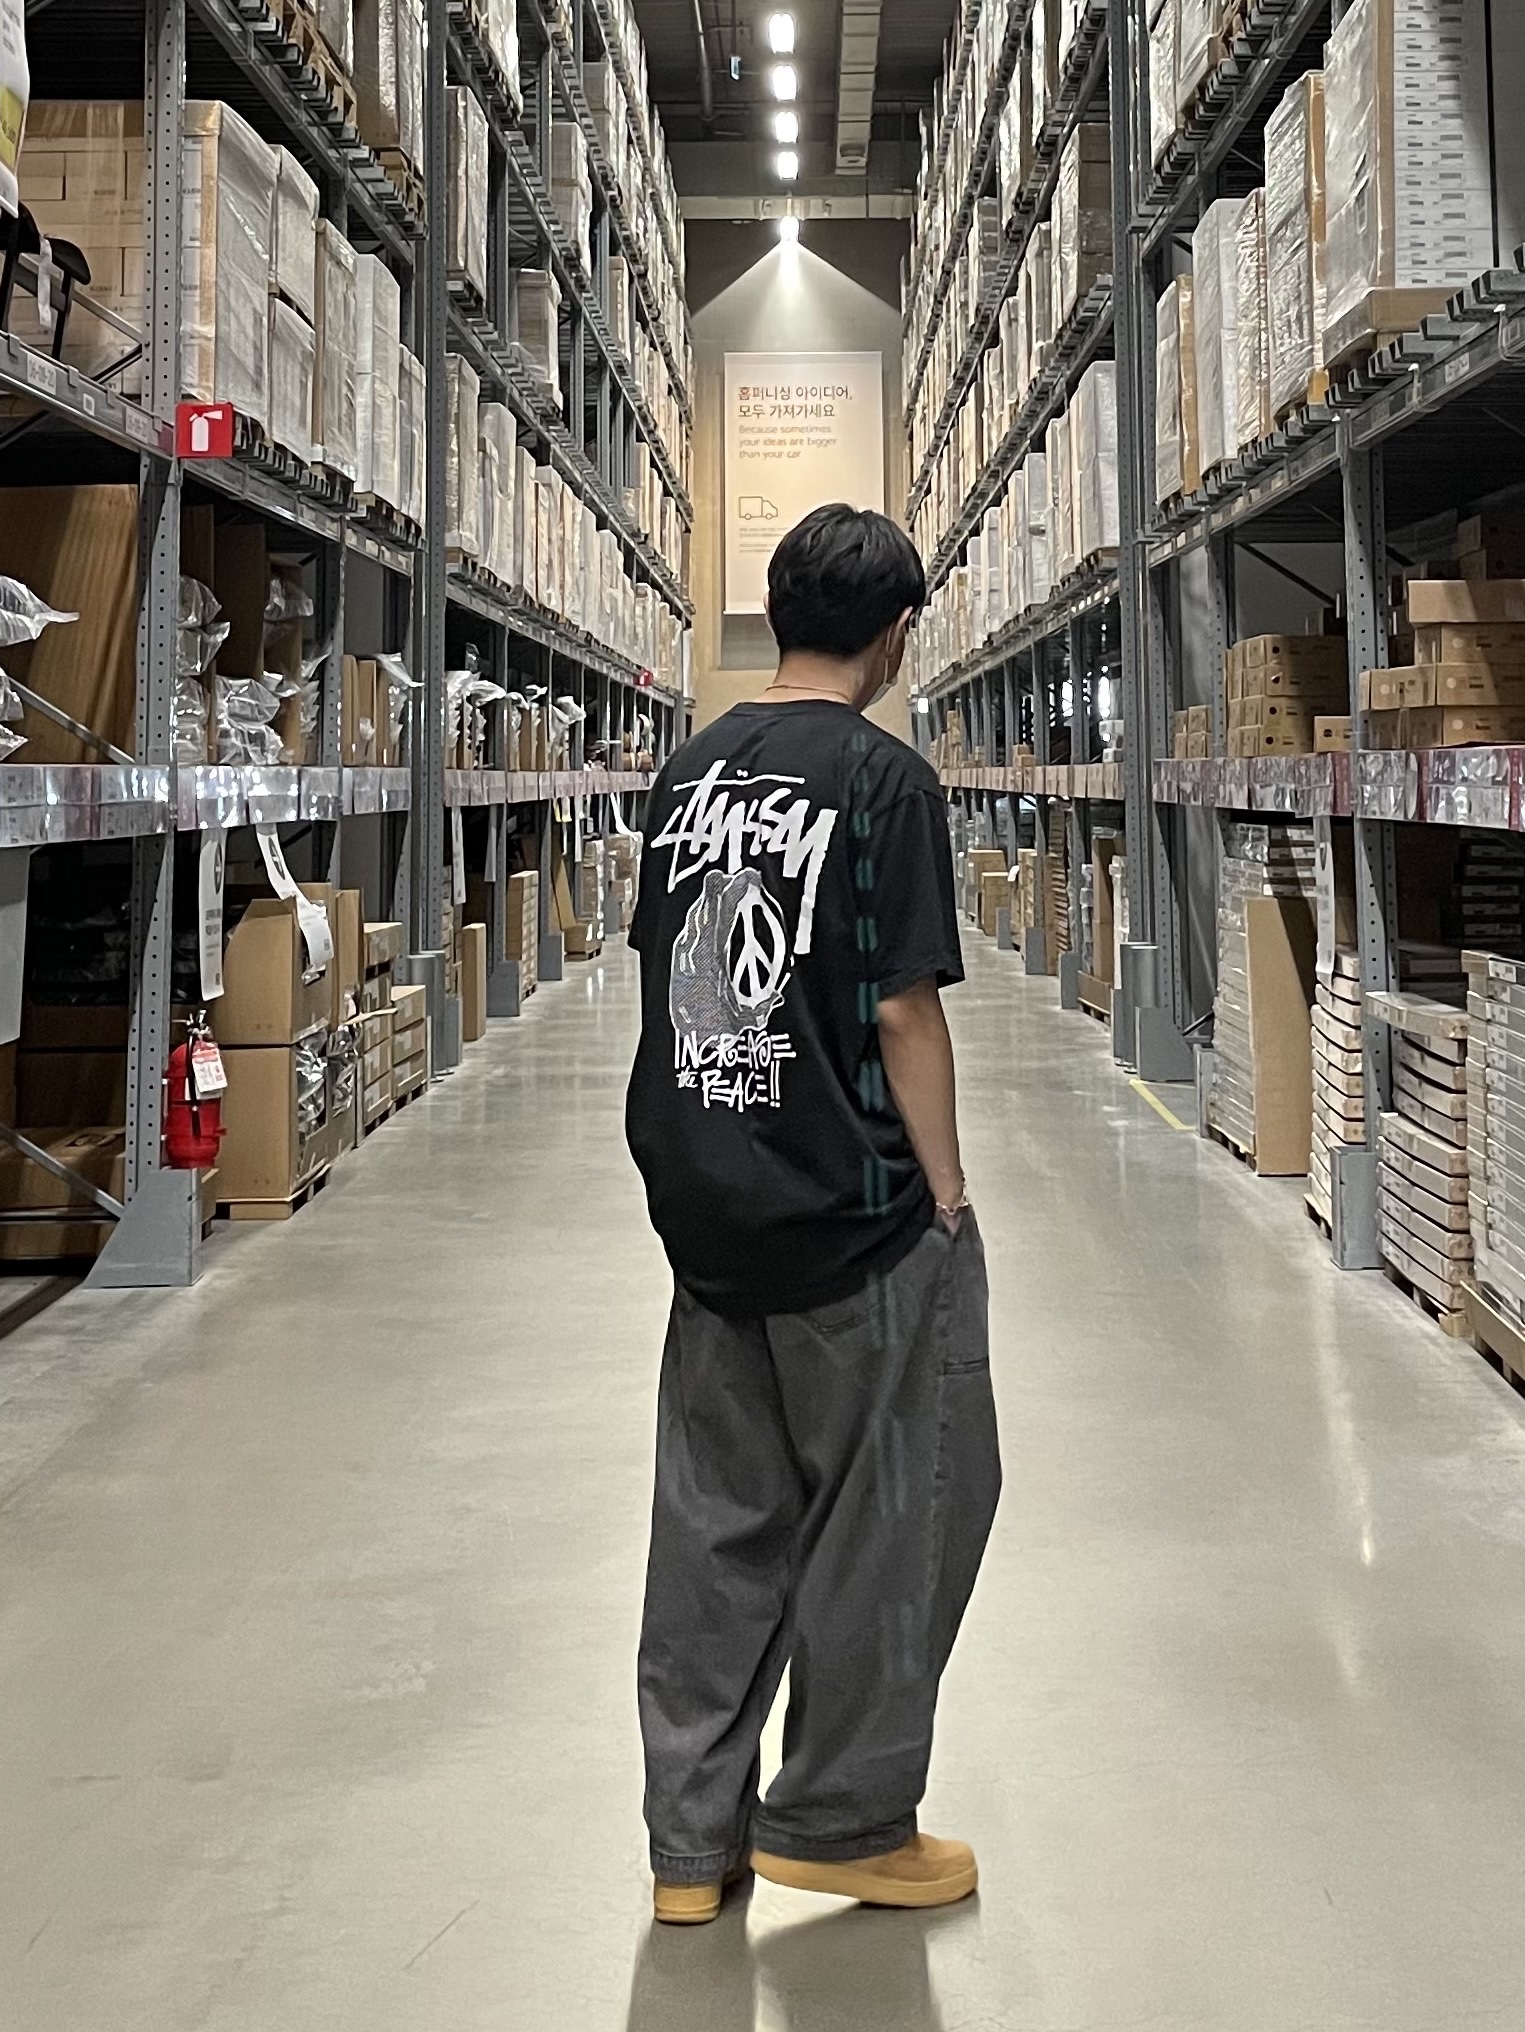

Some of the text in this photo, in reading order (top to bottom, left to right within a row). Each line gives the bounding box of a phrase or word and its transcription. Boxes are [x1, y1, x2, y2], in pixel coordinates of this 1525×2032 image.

[738, 385, 853, 401] 홈퍼니싱 아이디어,
[738, 404, 766, 419] 모두
[739, 424, 832, 434] Because sometimes
[739, 436, 838, 448] your ideas are bigger
[739, 450, 802, 460] than your car
[674, 1028, 797, 1070] INCREASE
